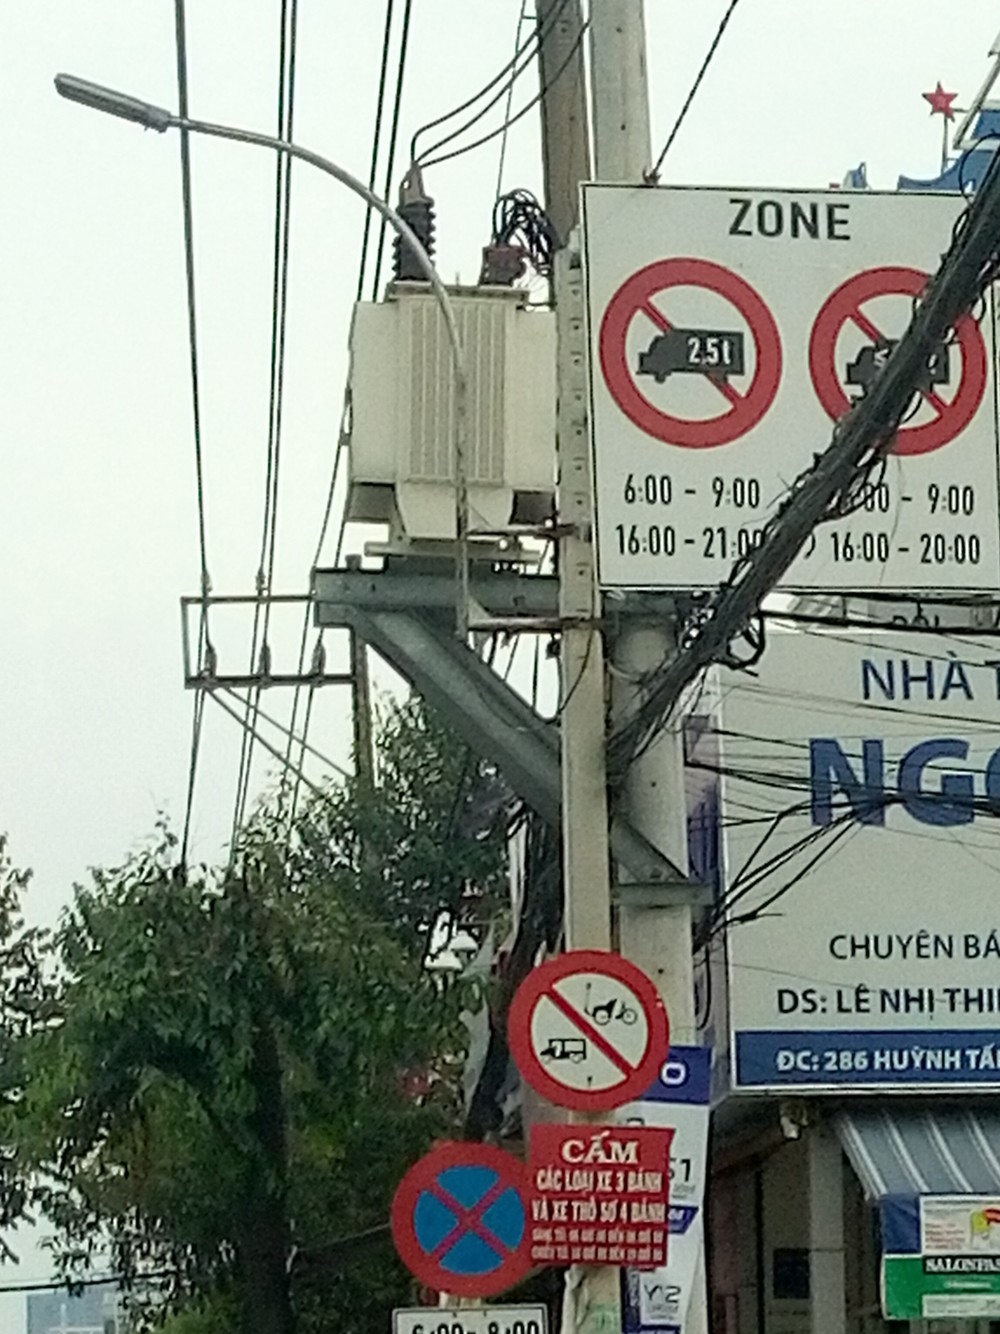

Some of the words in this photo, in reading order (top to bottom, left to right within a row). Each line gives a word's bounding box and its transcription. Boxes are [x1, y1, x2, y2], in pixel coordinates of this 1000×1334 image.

[728, 199, 851, 241] ZONE
[624, 473, 672, 505] 6:00
[712, 476, 760, 509] 9:00
[928, 483, 974, 516] 9:00
[615, 523, 675, 556] 16:00
[702, 526, 764, 559] 21:00
[831, 531, 889, 563] 16:00
[920, 532, 980, 565] 20:00
[860, 650, 974, 701] NHÀ
[829, 929, 954, 960] CHUYÊN
[777, 988, 828, 1014] DS:
[836, 983, 871, 1013] LÊ
[880, 987, 935, 1021] NHỊ
[776, 1050, 820, 1072] ĐC:
[825, 1049, 868, 1072] 286
[873, 1045, 961, 1071] HUỲNH
[561, 1130, 639, 1164] CẤM
[536, 1164, 563, 1192] CÁC
[597, 1171, 613, 1193] XE
[615, 1171, 625, 1193] 3
[552, 1200, 568, 1222] XE
[620, 1201, 628, 1224] 4
